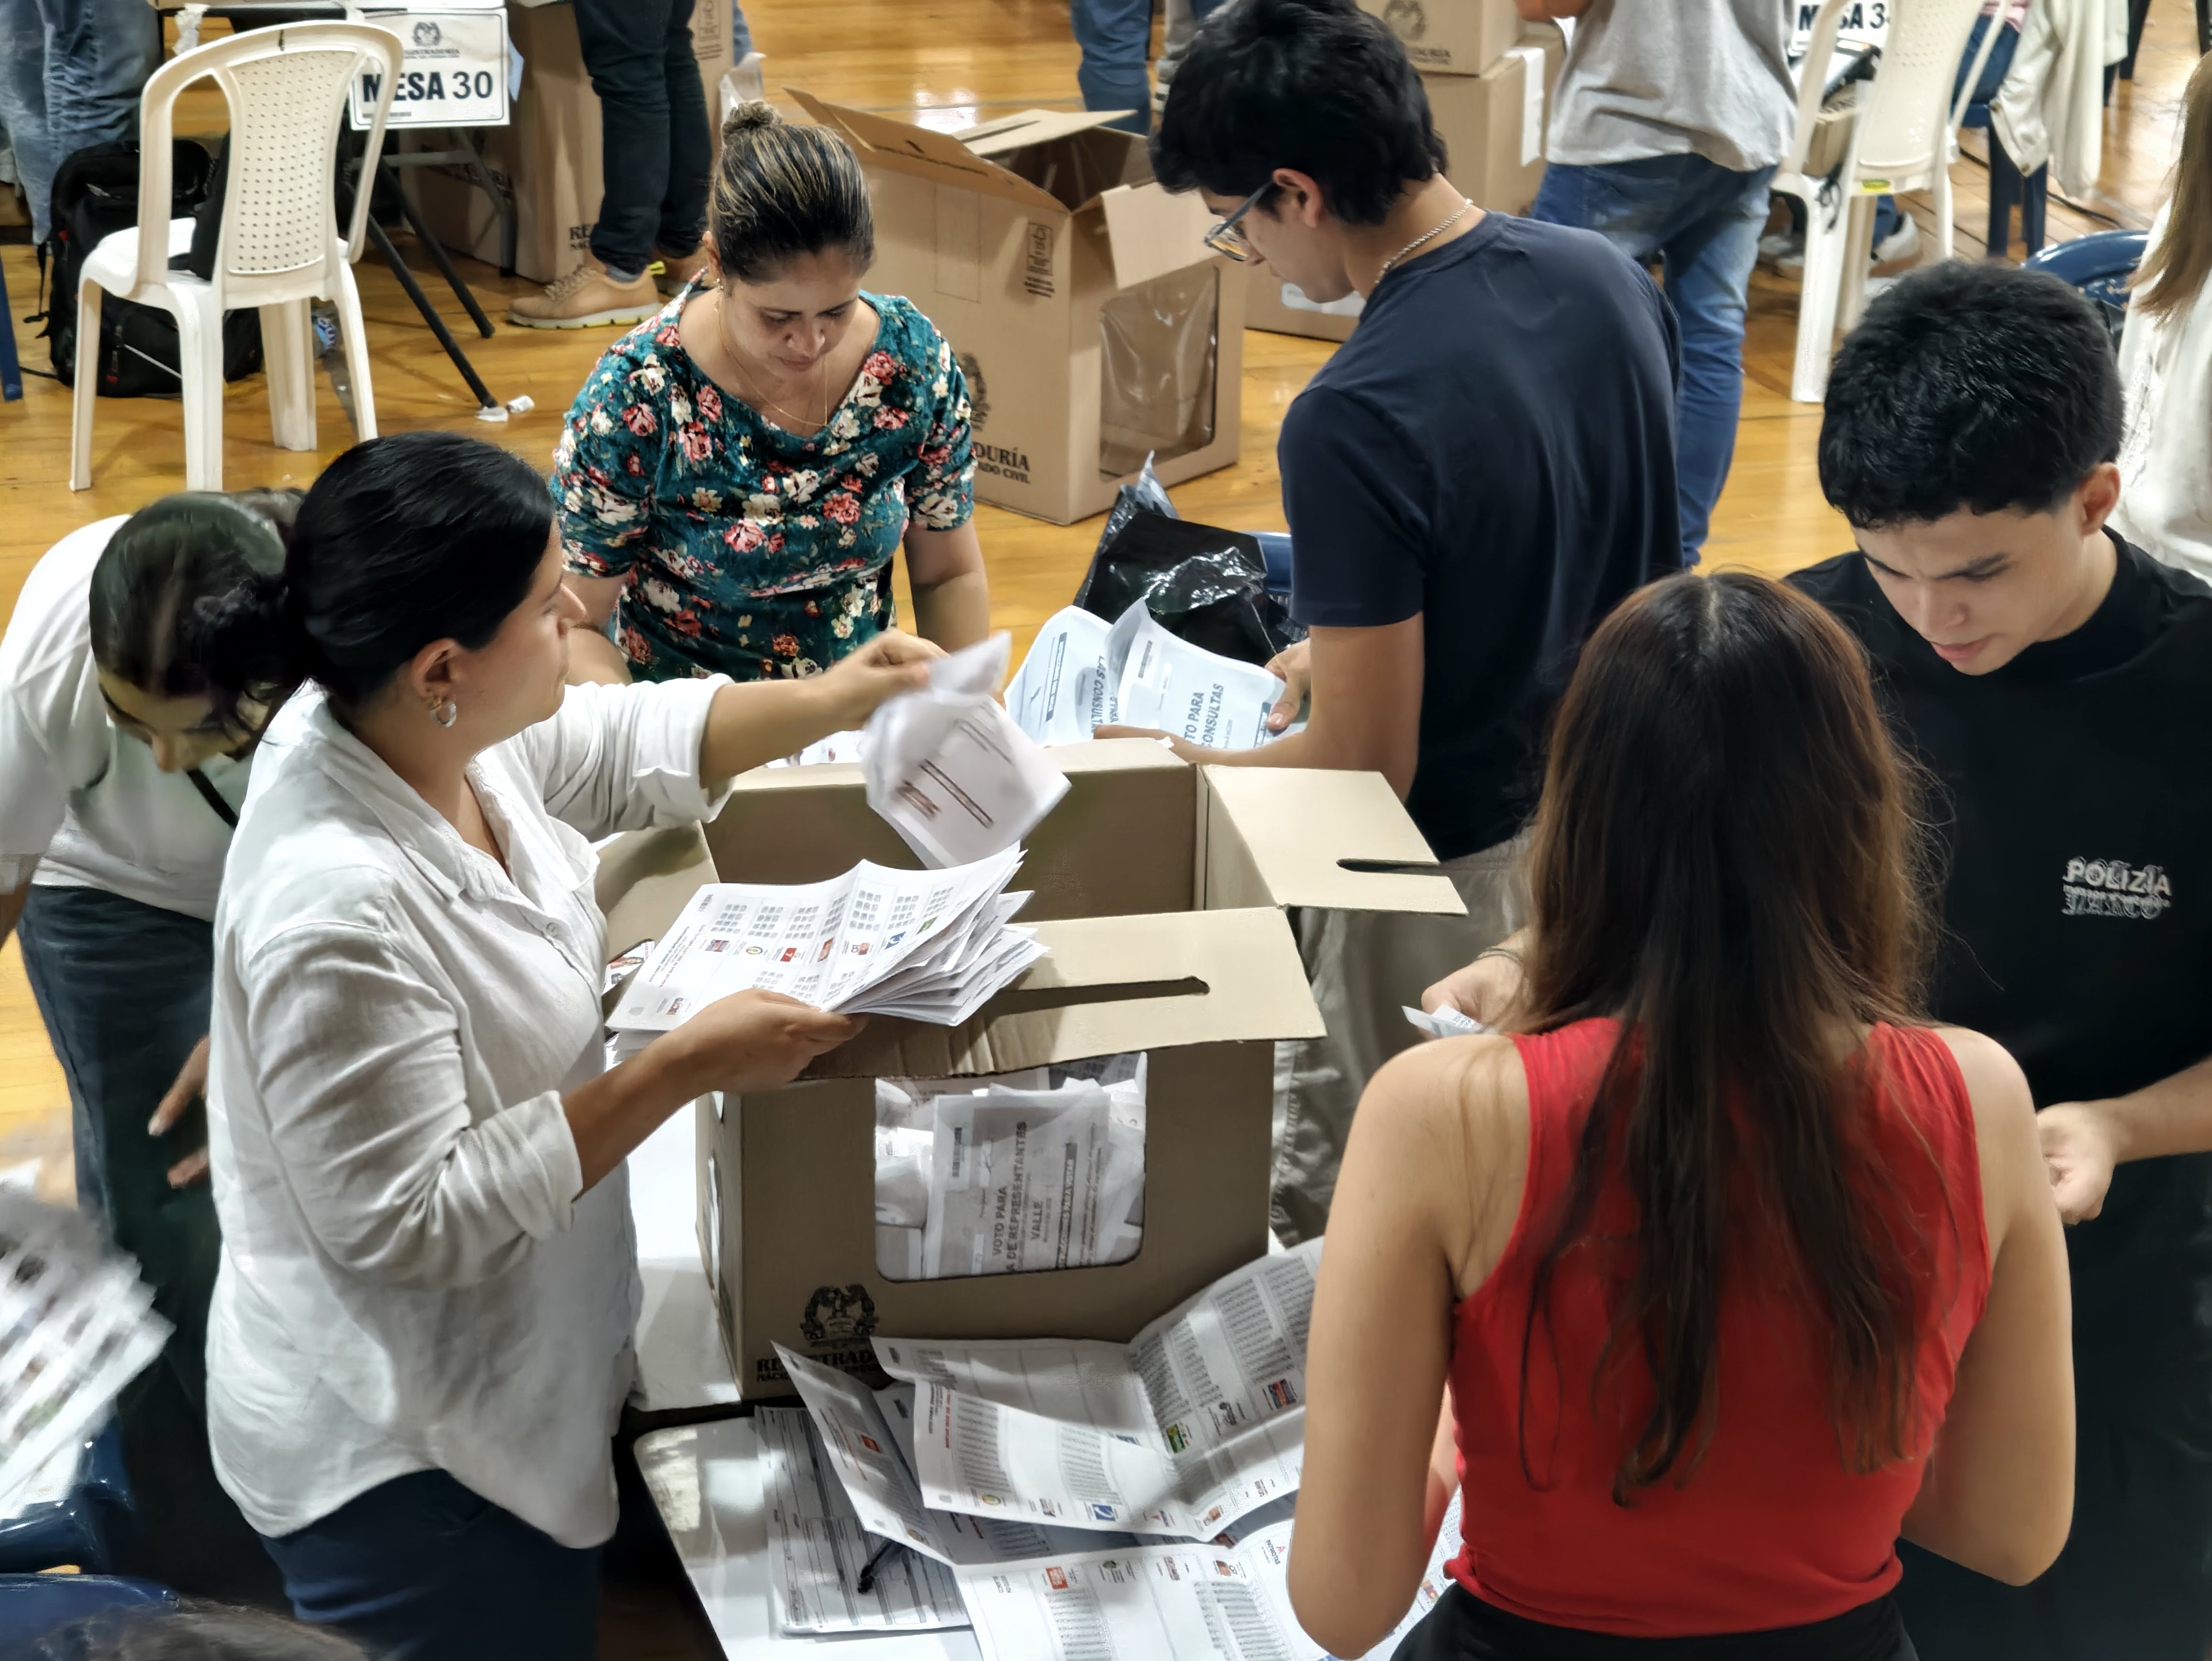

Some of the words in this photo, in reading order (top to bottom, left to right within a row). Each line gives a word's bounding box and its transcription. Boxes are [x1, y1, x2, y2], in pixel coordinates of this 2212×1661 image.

[362, 71, 446, 102] MESA
[453, 71, 493, 99] 30
[973, 441, 1030, 472] DURÍA
[1187, 692, 1205, 722] PARA
[1201, 683, 1224, 747] ONSULTAS
[1184, 724, 1197, 740] TO
[1008, 1121, 1027, 1239] REPRESENTANTES
[996, 1186, 1007, 1219] PARA
[1031, 1201, 1043, 1240] VALLE
[993, 1223, 1004, 1256] VOTO
[1006, 1243, 1018, 1260] DE
